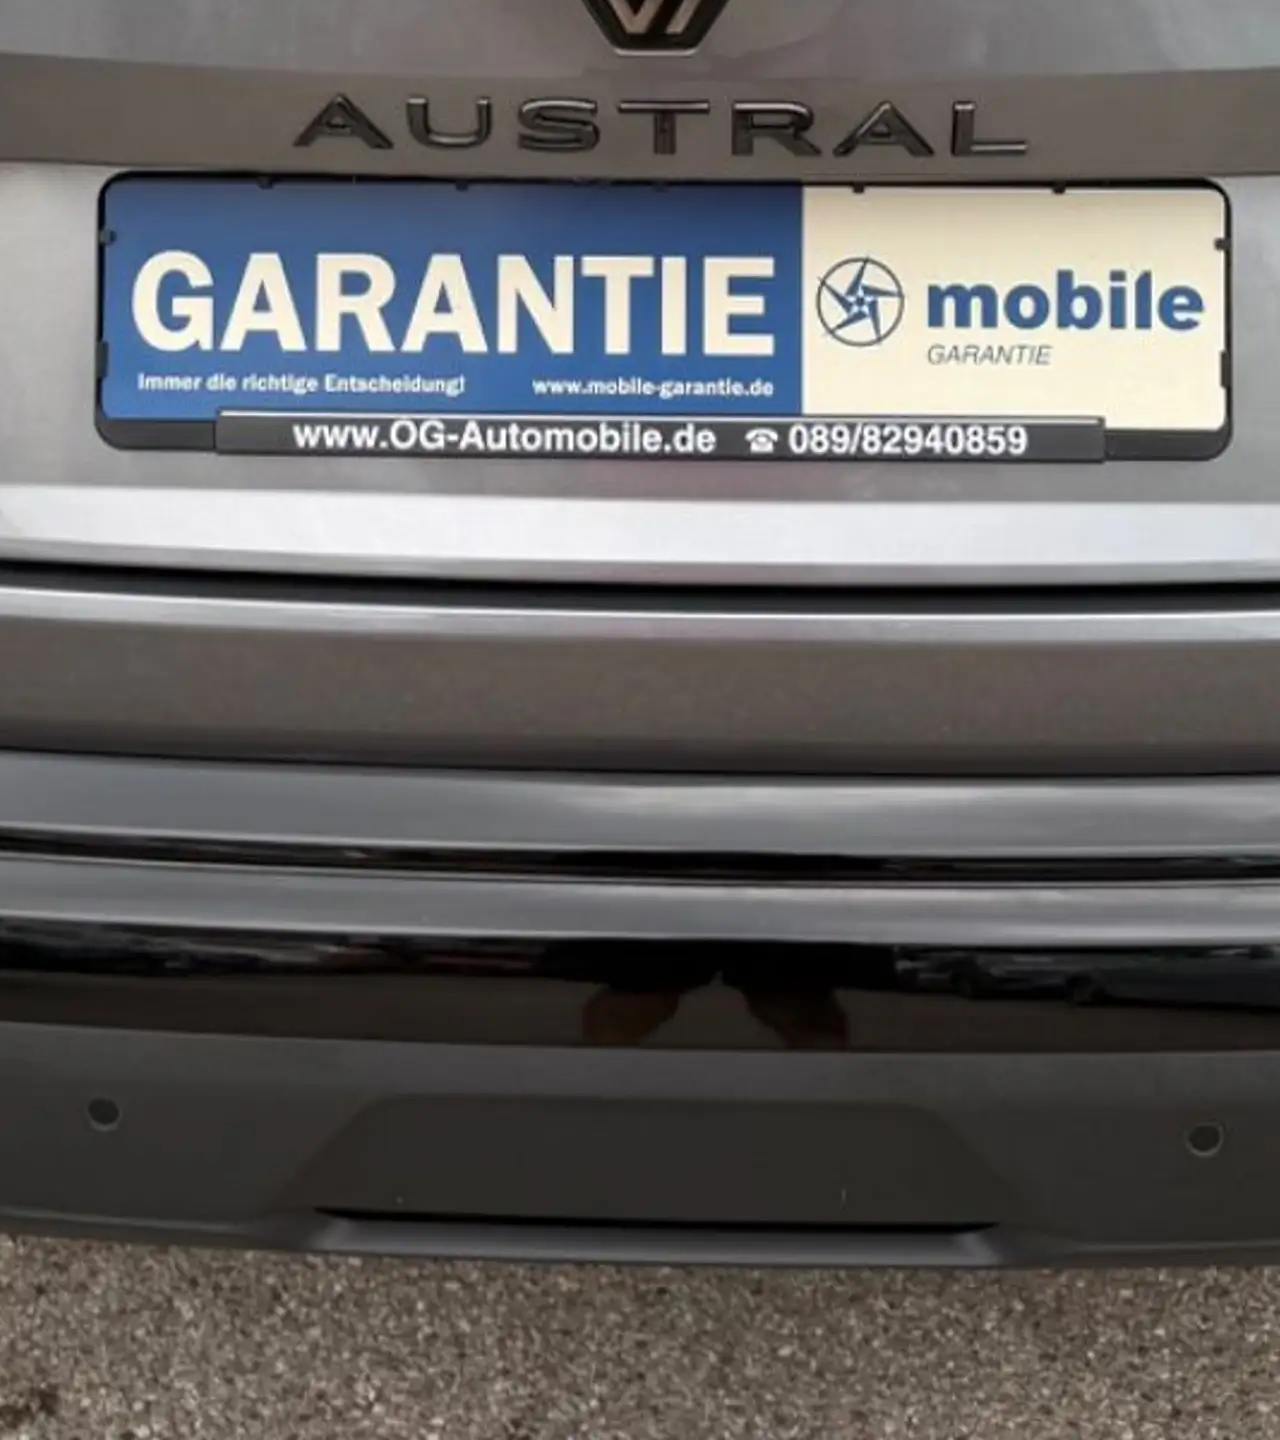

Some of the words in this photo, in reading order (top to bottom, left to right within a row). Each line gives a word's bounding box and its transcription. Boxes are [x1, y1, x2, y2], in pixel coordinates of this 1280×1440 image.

[292, 92, 1028, 157] AUSTRAL
[131, 249, 775, 356] GARANTIE
[927, 268, 1205, 331] mobile
[927, 344, 1053, 366] GARANTIE
[138, 372, 202, 392] Immer
[205, 372, 237, 392] die
[242, 372, 318, 396] richtige
[324, 373, 466, 398] Entscheidung!
[531, 376, 775, 400] www.mobile-garantie.de
[292, 419, 717, 454] www.OG-Automobile.de
[788, 423, 1029, 455] 089/82940859
